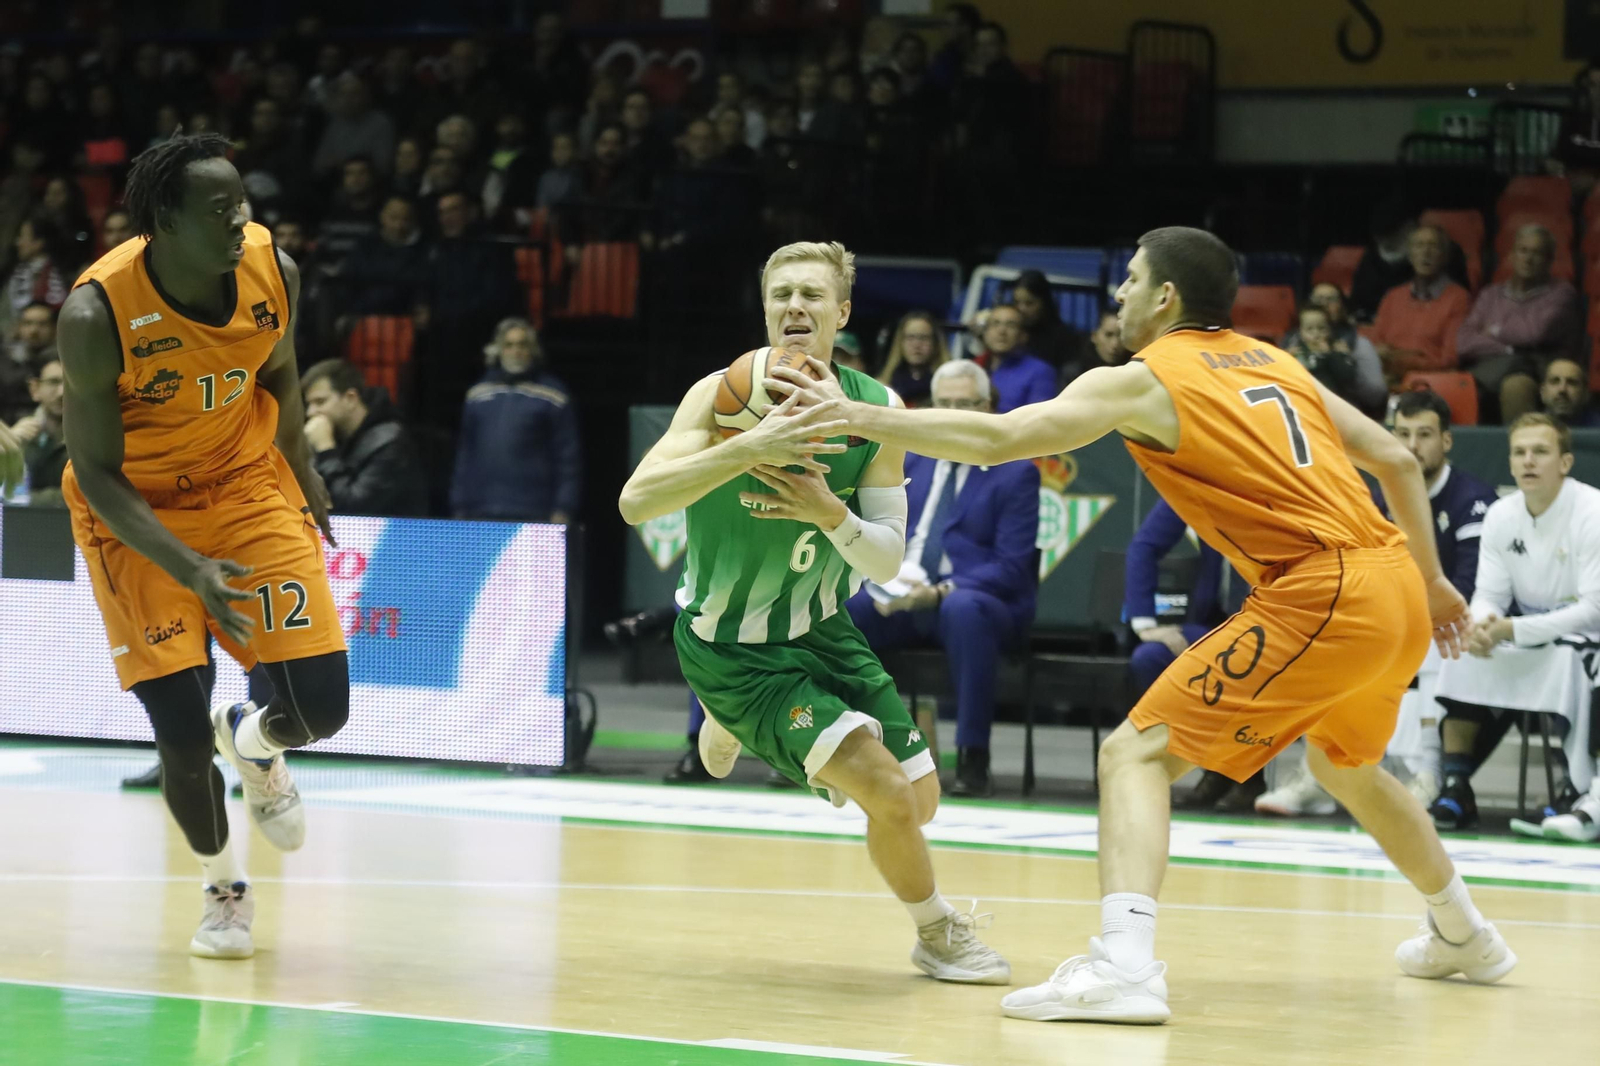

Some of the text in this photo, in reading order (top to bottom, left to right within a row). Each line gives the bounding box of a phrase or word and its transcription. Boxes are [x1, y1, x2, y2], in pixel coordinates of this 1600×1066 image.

[257, 315, 273, 326] LEB
[197, 368, 249, 411] 12
[1238, 383, 1313, 468] 7
[789, 530, 817, 573] 6
[256, 580, 310, 632] 12
